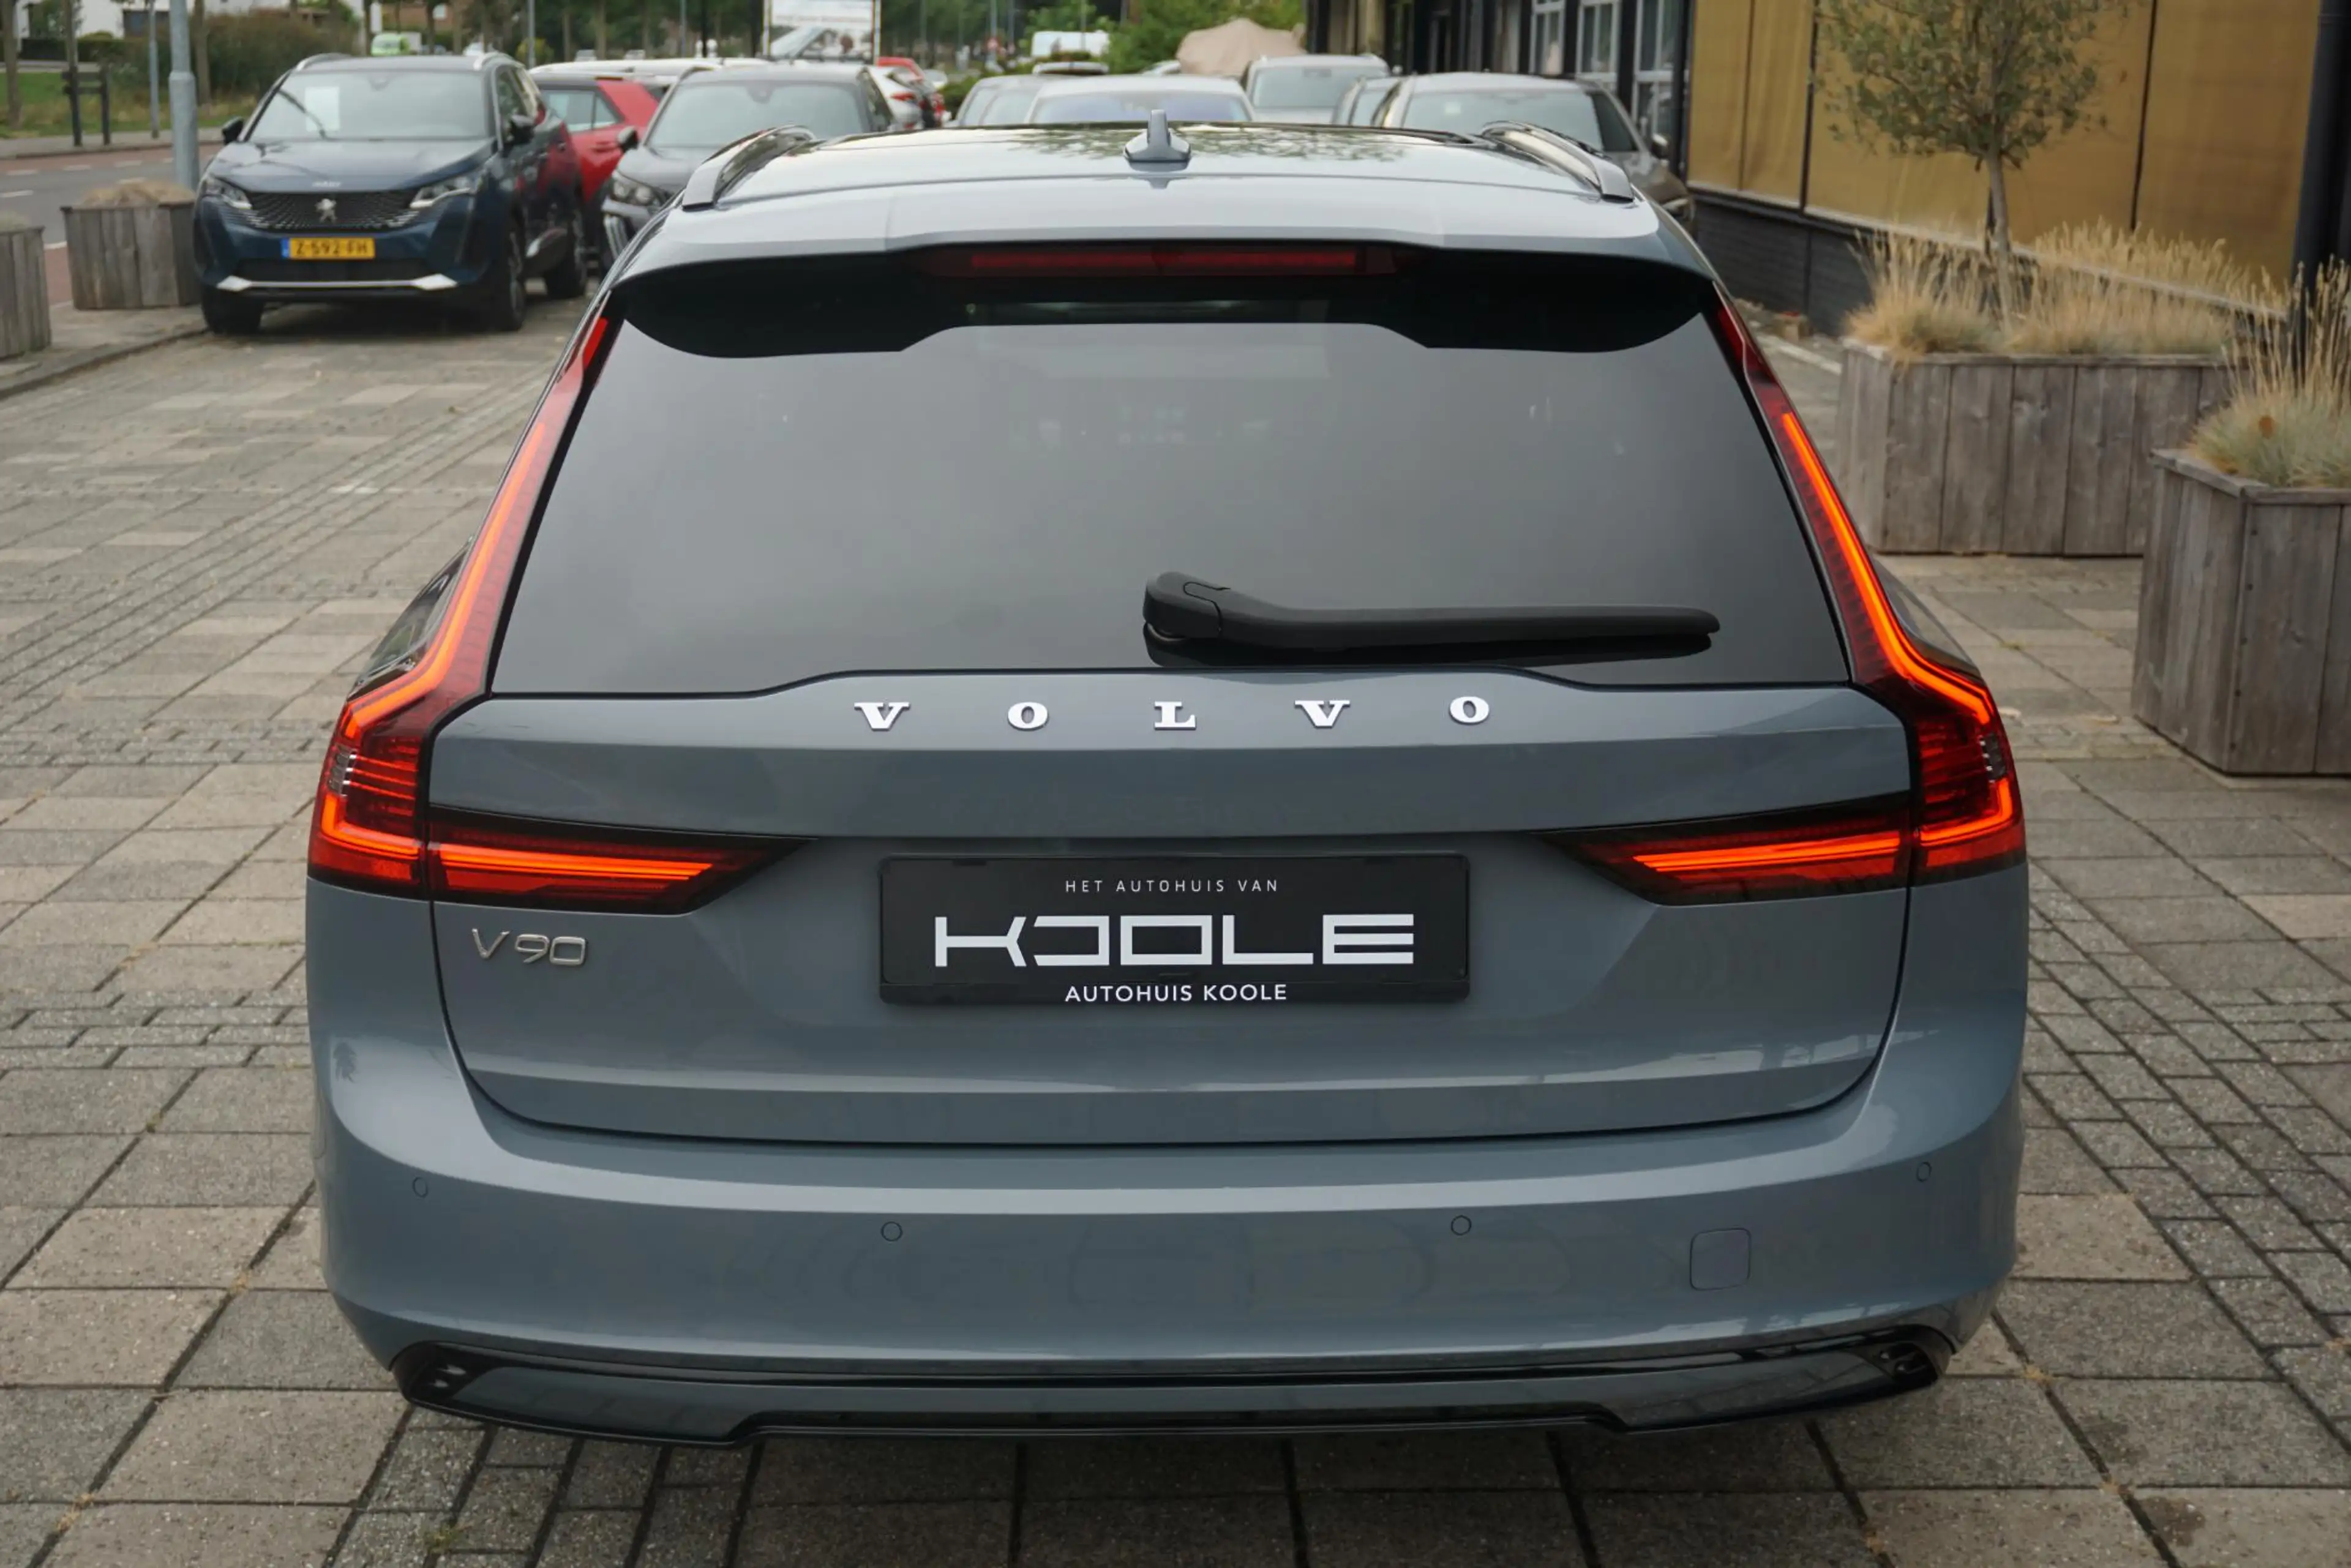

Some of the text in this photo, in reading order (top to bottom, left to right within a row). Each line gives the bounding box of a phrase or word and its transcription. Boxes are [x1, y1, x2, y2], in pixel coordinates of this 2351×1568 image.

[854, 696, 1489, 729] VOLVO
[1065, 879, 1277, 893] HET AUTOHUIS VAN
[471, 928, 587, 966] V90
[935, 913, 1414, 967] KOOLE
[1065, 983, 1288, 1003] AUTOHUIS KOOLE
